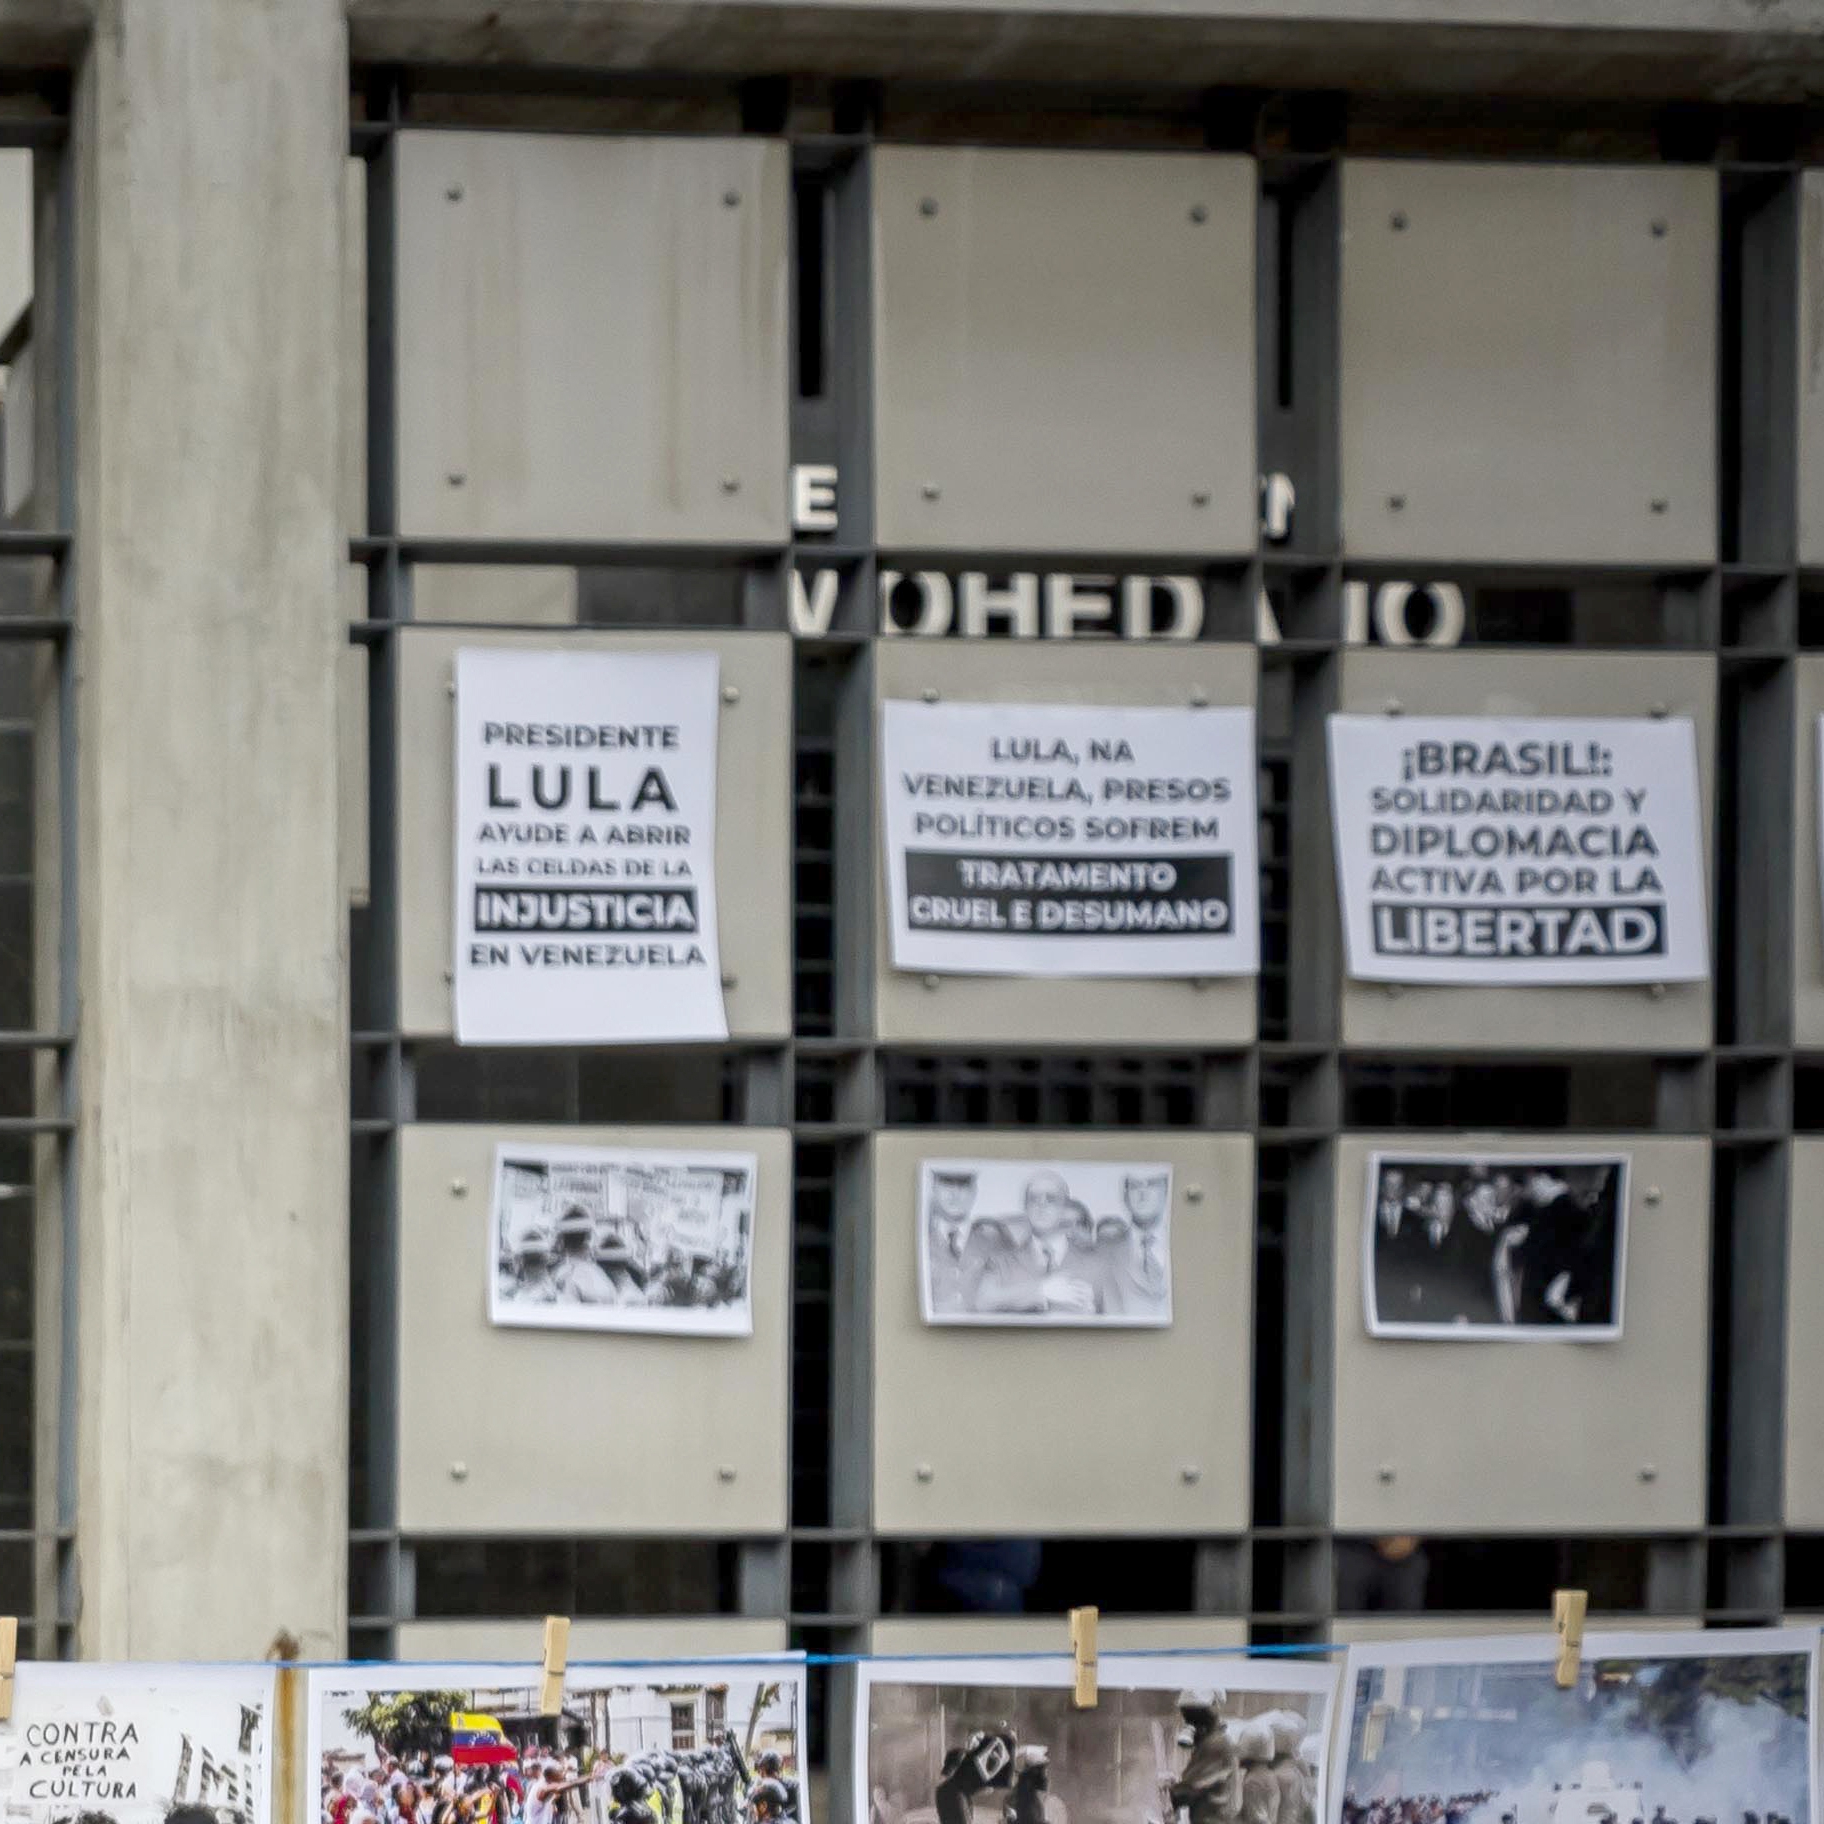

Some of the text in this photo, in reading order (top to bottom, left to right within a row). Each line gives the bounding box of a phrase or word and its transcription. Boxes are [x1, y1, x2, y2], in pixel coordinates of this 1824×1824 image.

[788, 570, 1466, 648] OHEDO
[484, 723, 680, 748] PRESIDENTE
[991, 737, 1133, 767] LULA, NA
[488, 763, 678, 812] LULA
[903, 771, 1232, 804] VENEZUELA, PRESOS
[1371, 787, 1646, 817] SOLIDARIDAD Y
[478, 823, 691, 846] AYUDE A ABRIR
[914, 809, 1219, 841] POLÍTICOS SOFREM
[1370, 824, 1660, 860] DIPLOMACIA
[478, 857, 692, 876] LAS CELDAS DE LA
[960, 860, 1176, 891] TRATAMENTO
[1372, 866, 1663, 895] ACTIVA POR LA
[478, 892, 696, 928] INJUSTICIA
[913, 896, 1229, 929] CRUEL E DESUMANO
[1379, 911, 1656, 953] LIBERTAD
[471, 943, 707, 968] EN VENEZUELA
[27, 1722, 139, 1746] CONTRA
[20, 1747, 130, 1766] A CENSURA
[62, 1766, 107, 1776] PELA
[29, 1780, 137, 1799] CULTURA
